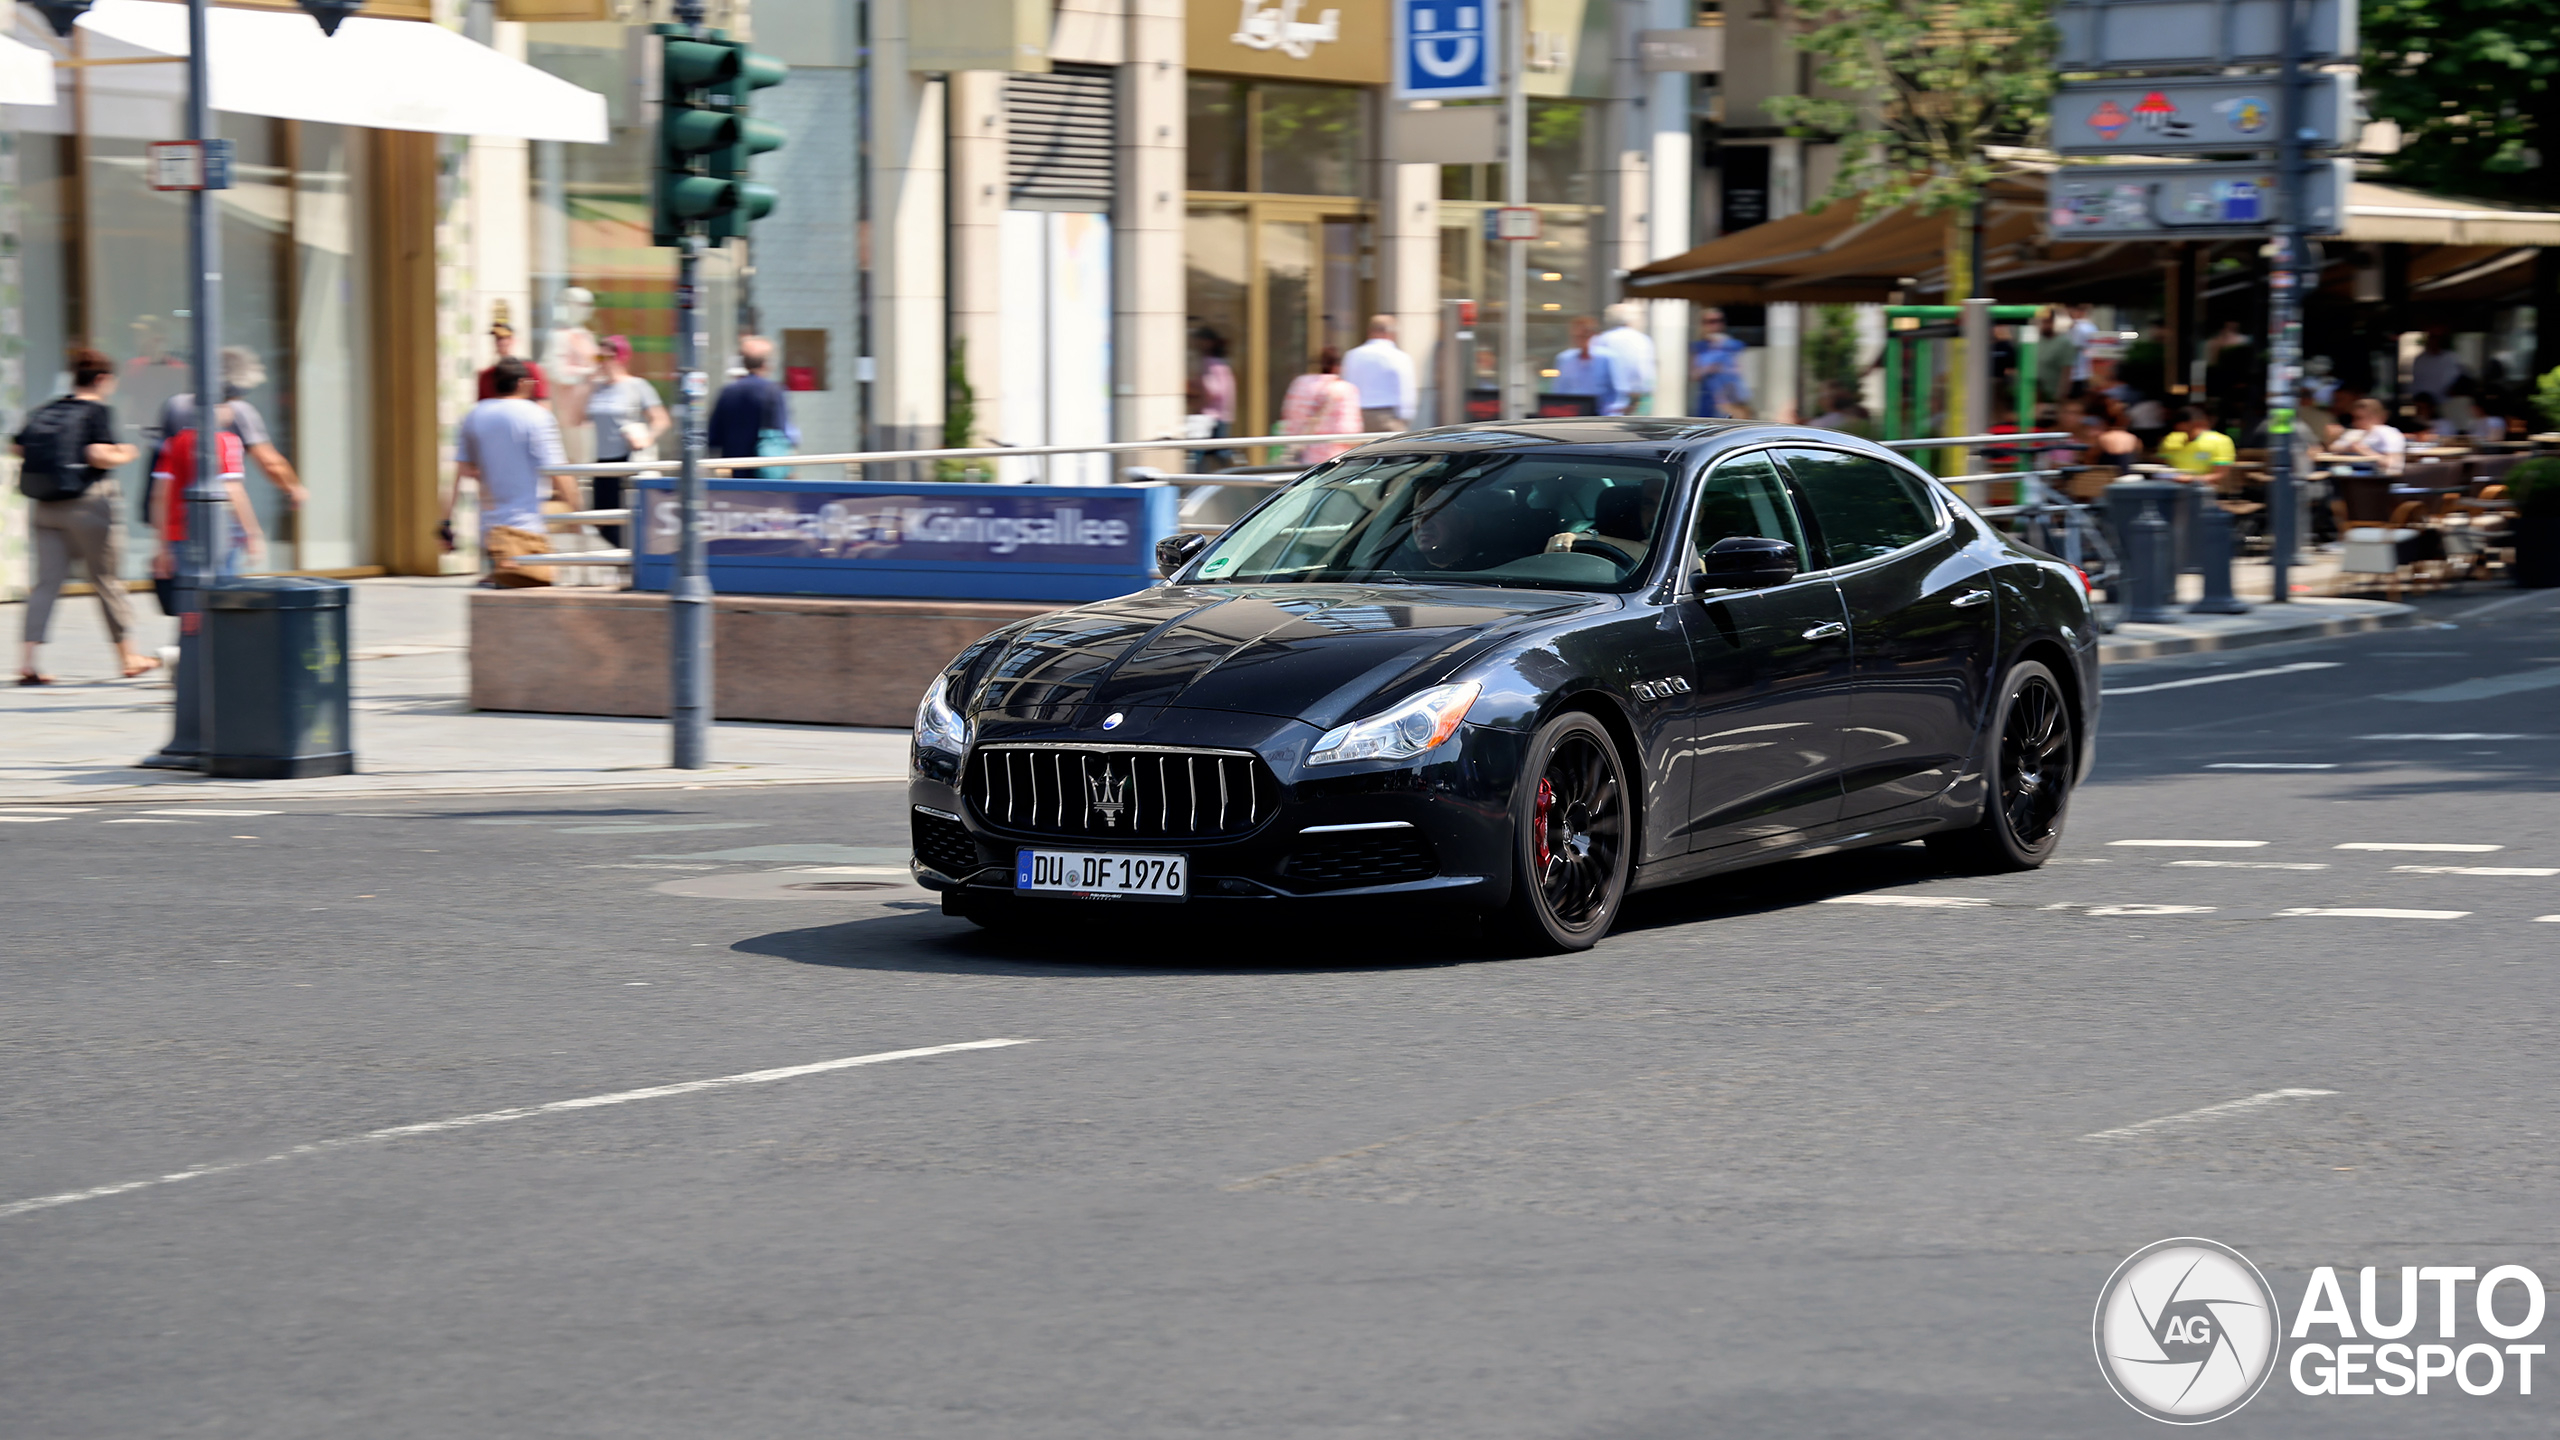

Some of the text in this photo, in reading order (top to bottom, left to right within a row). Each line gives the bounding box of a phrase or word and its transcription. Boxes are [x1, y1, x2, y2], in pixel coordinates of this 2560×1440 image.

[1413, 7, 1479, 77] U
[654, 501, 871, 541] Seinstraße
[902, 506, 1130, 553] Königsallee
[1033, 855, 1181, 890] DU DF 1976
